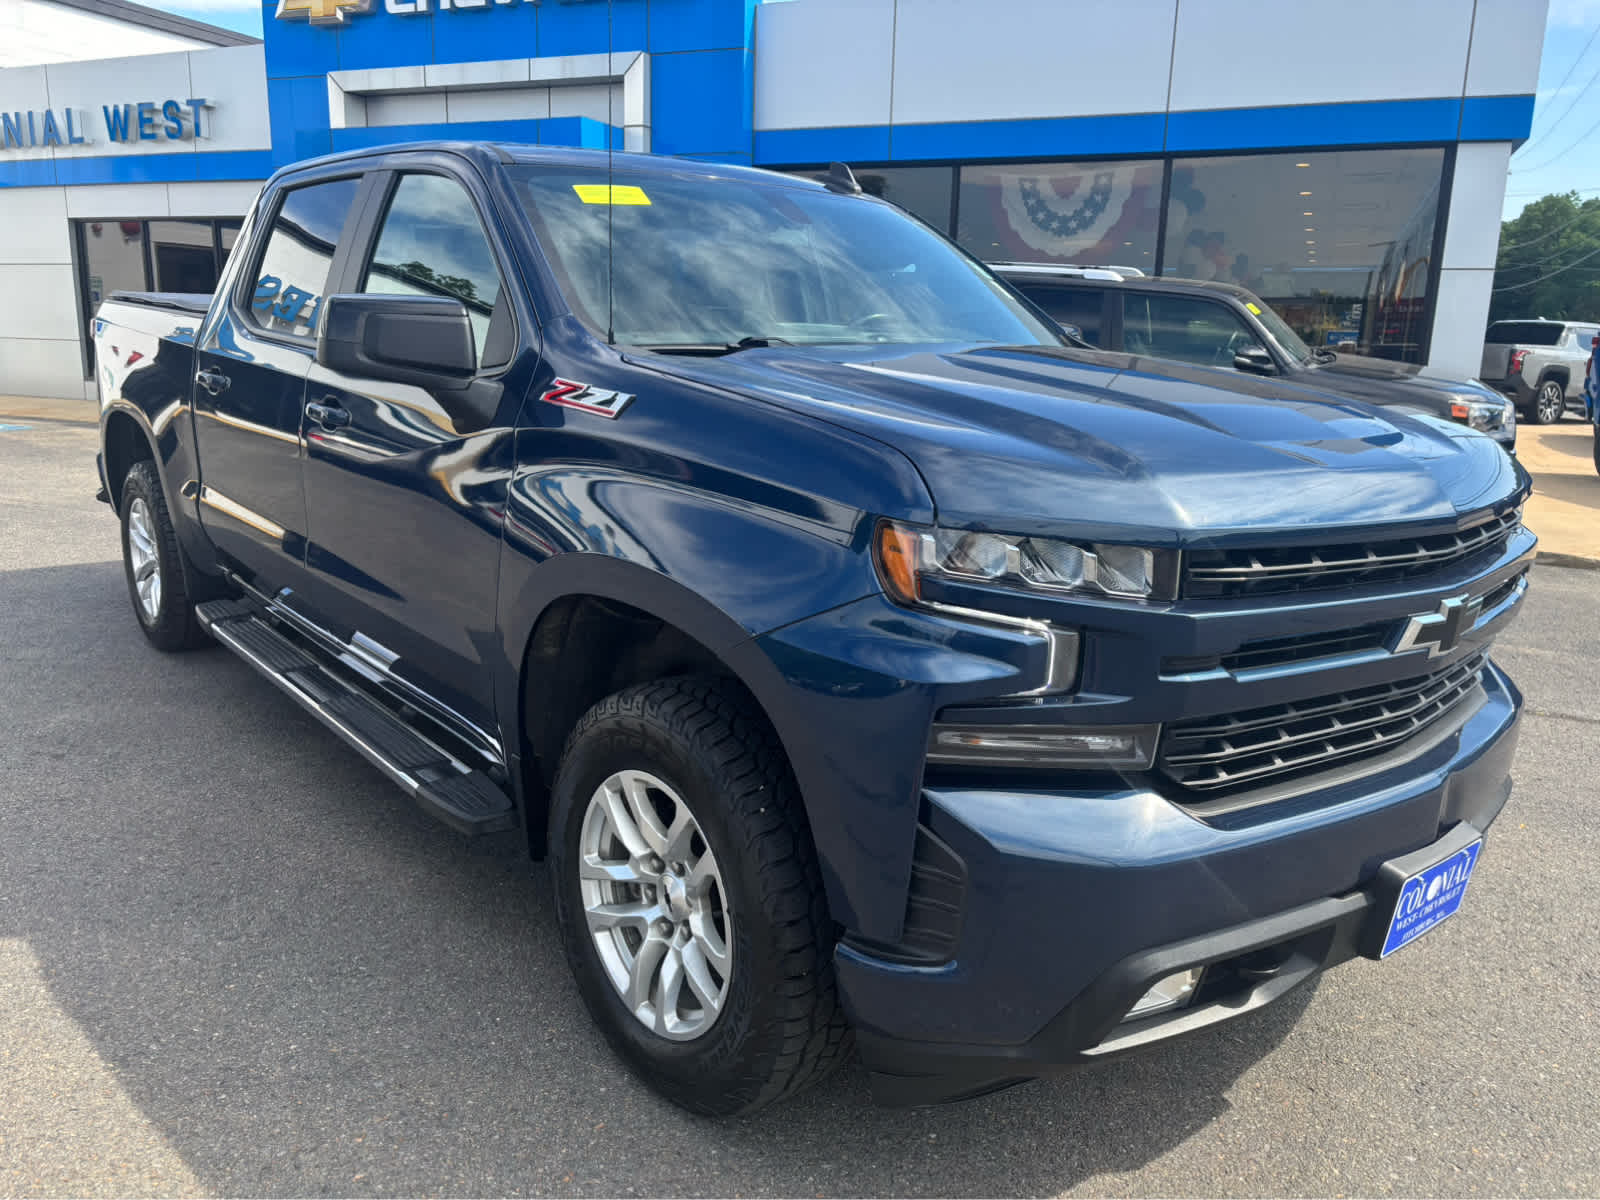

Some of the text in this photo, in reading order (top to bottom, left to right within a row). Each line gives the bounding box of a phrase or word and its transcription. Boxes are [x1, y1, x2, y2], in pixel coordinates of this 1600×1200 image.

[1, 98, 207, 148] NIAL WEST
[539, 377, 636, 420] Z71
